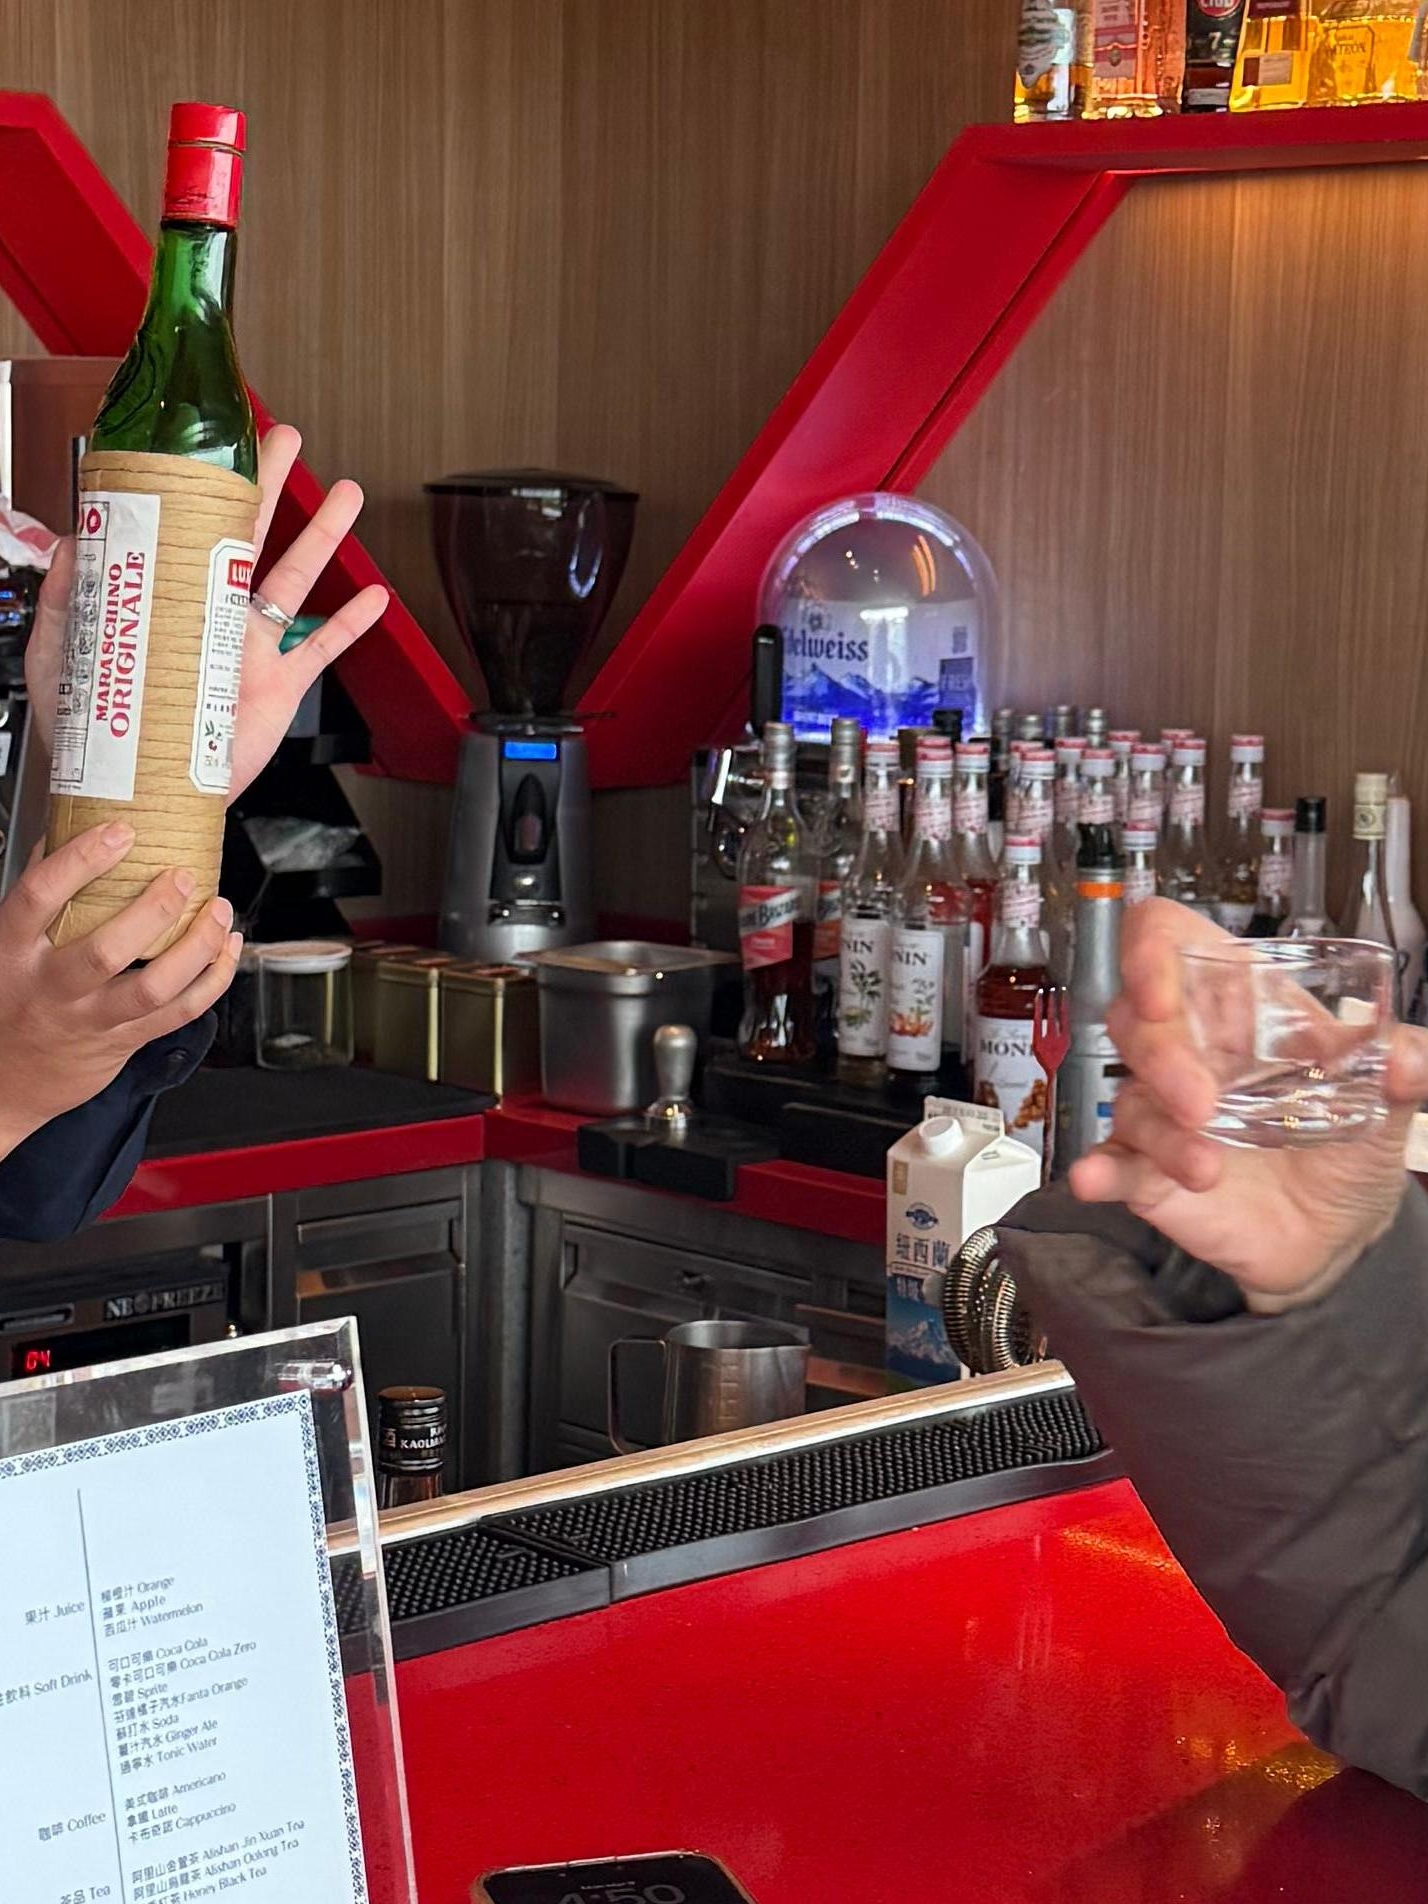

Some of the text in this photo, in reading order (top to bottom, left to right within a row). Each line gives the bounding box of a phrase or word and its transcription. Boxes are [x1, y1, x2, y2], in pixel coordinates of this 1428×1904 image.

[1209, 32, 1222, 49] 7
[95, 562, 124, 722] MARASCHINO
[109, 550, 146, 739] ORIGINALE
[137, 1576, 176, 1595] Orange
[25, 1600, 86, 1625] 果汁 Juice
[131, 1594, 166, 1613] Apple
[104, 1601, 204, 1637] 西瓜汁 Watermelon
[108, 1637, 208, 1673] 可口可樂 Coca Cola
[180, 1654, 207, 1670] Coca
[208, 1647, 232, 1663] Cola
[233, 1640, 257, 1656] Zero
[33, 1679, 59, 1696] Soft
[60, 1668, 93, 1689] Drink
[137, 1682, 169, 1701] Sprite
[211, 1676, 249, 1695] Orange
[152, 1714, 180, 1730] Soda
[165, 1724, 200, 1744] Ginger
[200, 1718, 218, 1734] Ale
[156, 1746, 186, 1764] Tonic
[186, 1736, 218, 1753] Water
[171, 1771, 227, 1796] Americano
[67, 1811, 107, 1833] Coffee
[151, 1804, 179, 1820] Latte
[175, 1802, 237, 1830] Cappuccino
[202, 1841, 240, 1861] Alishan
[241, 1834, 258, 1849] Jin
[258, 1826, 286, 1843] Xuan
[204, 1857, 242, 1877] Alishan
[88, 1884, 112, 1902] Tea
[183, 1886, 217, 1903] Honey
[218, 1872, 248, 1891] Black
